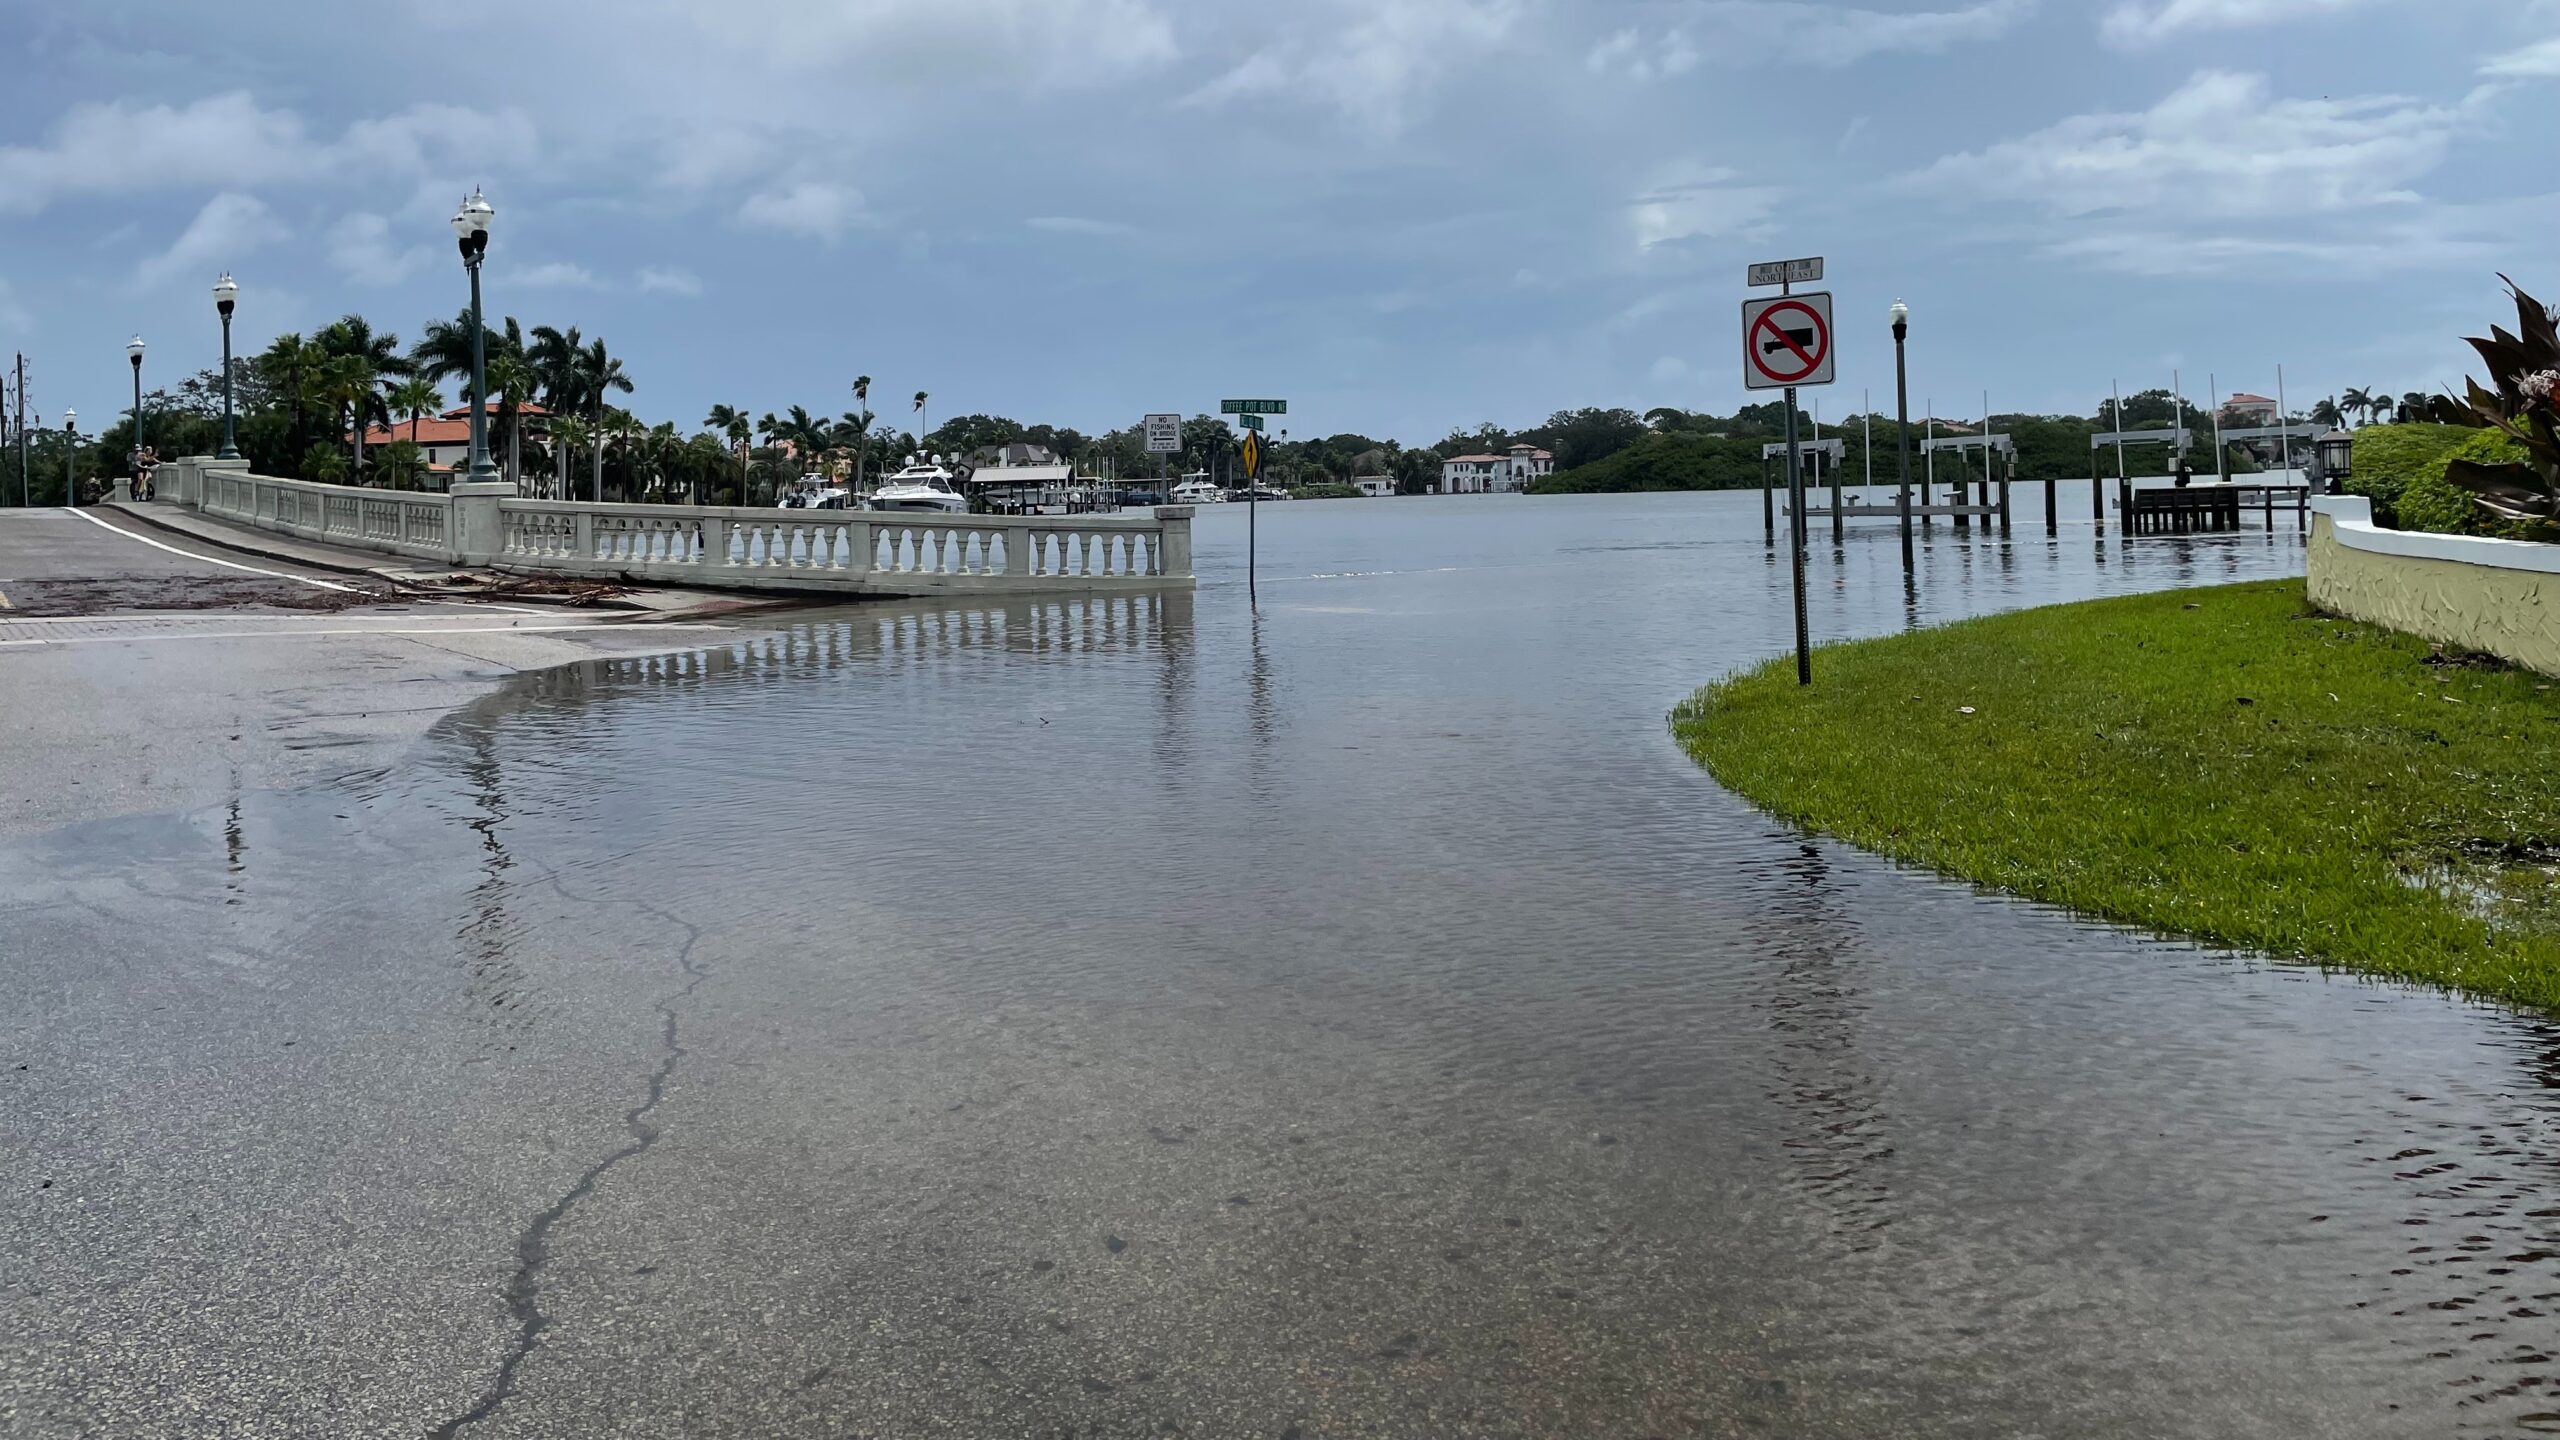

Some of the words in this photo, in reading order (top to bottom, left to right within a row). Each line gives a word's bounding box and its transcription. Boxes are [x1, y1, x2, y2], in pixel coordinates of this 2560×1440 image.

[1775, 263, 1795, 273] OD
[1222, 401, 1243, 412] COFFEE
[1246, 401, 1257, 412] POT
[1260, 401, 1275, 413] BLVD
[1278, 402, 1286, 413] NE
